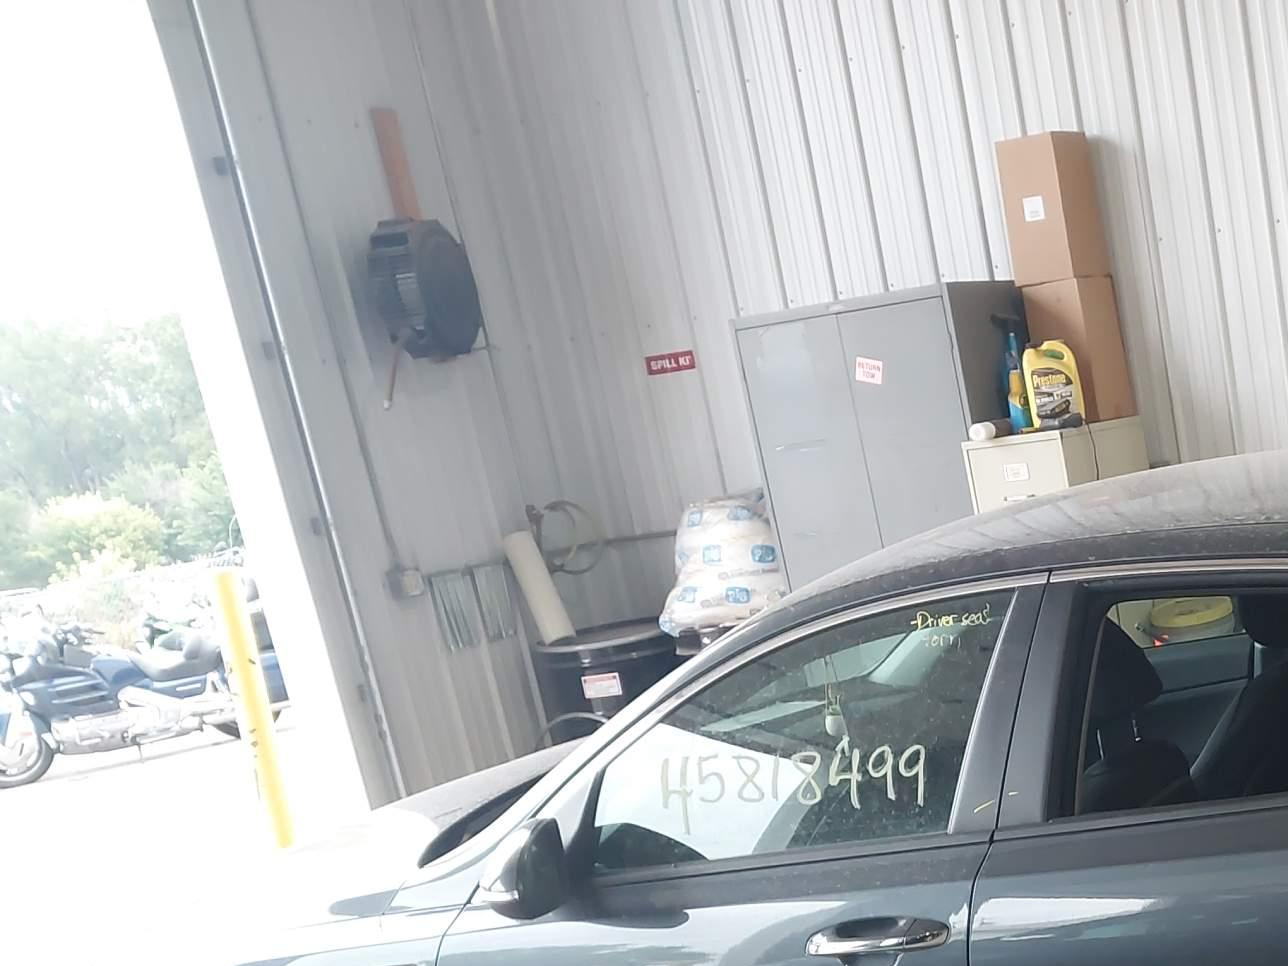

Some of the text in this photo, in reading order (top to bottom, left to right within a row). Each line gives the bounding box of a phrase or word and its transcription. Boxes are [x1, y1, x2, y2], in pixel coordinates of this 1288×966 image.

[650, 358, 677, 370] SPILL
[1032, 374, 1066, 388] Prestone
[660, 743, 927, 836] 45818499
